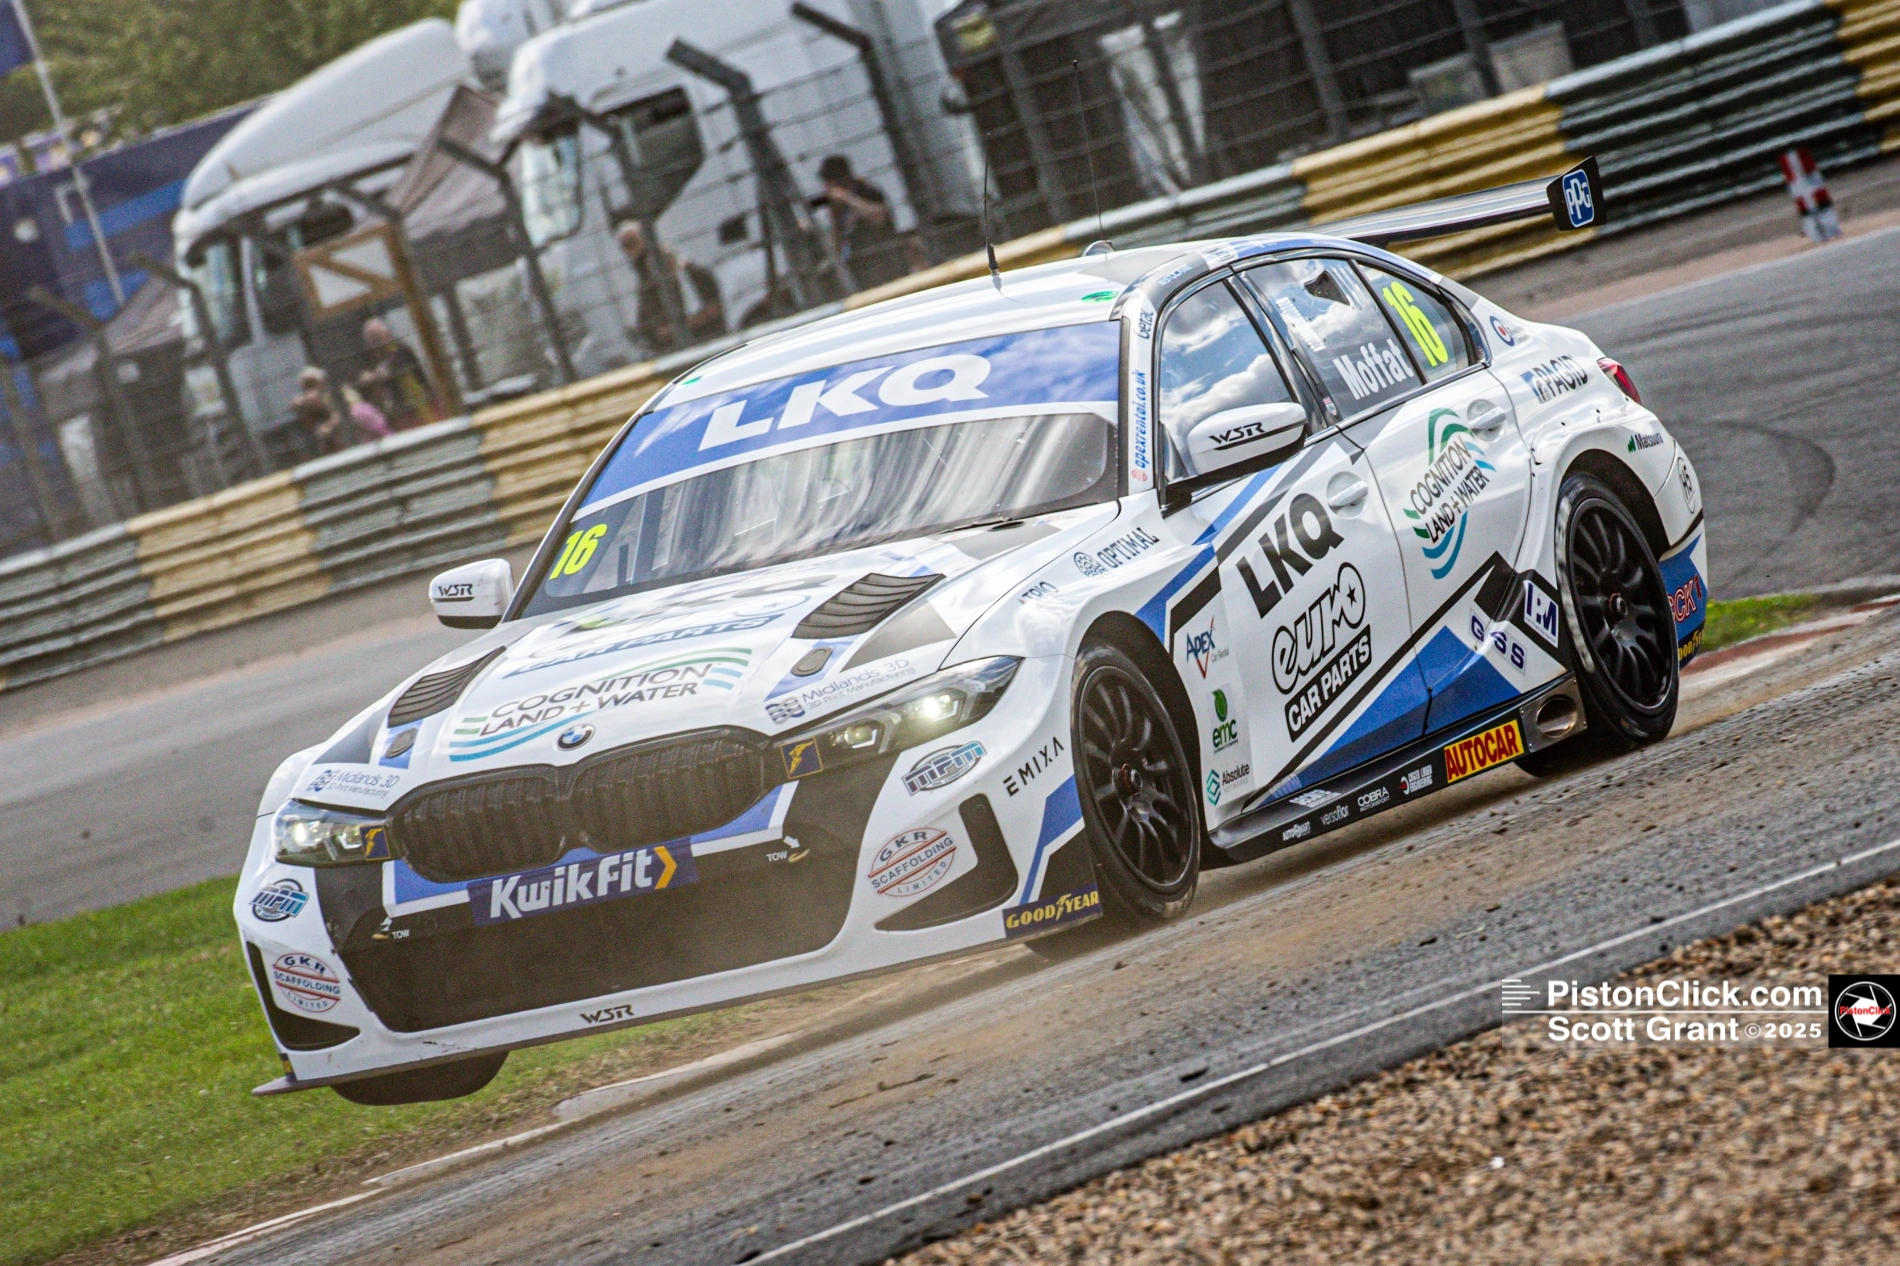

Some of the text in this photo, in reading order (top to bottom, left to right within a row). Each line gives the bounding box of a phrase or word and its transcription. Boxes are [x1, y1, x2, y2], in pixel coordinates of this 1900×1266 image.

[1565, 178, 1593, 221] PPG
[1382, 281, 1448, 367] 16
[1333, 339, 1414, 400] Moffat
[698, 354, 993, 451] LKQ
[1131, 369, 1150, 468] apexrental.co.uk
[1209, 421, 1266, 444] WSR
[1410, 435, 1472, 515] COGNITION
[1425, 502, 1455, 544] LAND
[1453, 465, 1490, 508] WATER
[550, 524, 608, 579] 16
[1097, 527, 1160, 568] OPTIMAL
[1236, 493, 1345, 619] LKQ
[438, 583, 473, 596] WSR
[1187, 628, 1216, 662] APEX
[492, 664, 714, 718] COGNITION
[802, 659, 910, 703] Midlands 3D
[1288, 635, 1369, 732] CAR PARTS
[479, 706, 564, 737] LAND
[597, 682, 699, 709] WATER
[1445, 724, 1519, 780] AUTOCAR
[380, 774, 400, 788] 3D
[1222, 763, 1250, 786] Absolute
[1357, 786, 1389, 807] COBRA
[766, 851, 788, 862] TOW
[872, 837, 953, 888] SCAFFOLDING
[880, 832, 928, 862] GKR
[898, 861, 946, 893] LIMITED
[1006, 891, 1099, 929] GOODYEAR
[392, 929, 410, 940] TOW
[273, 970, 340, 995] SCAFFOLDING
[284, 956, 326, 975] GKR
[579, 1004, 634, 1024] WSR
